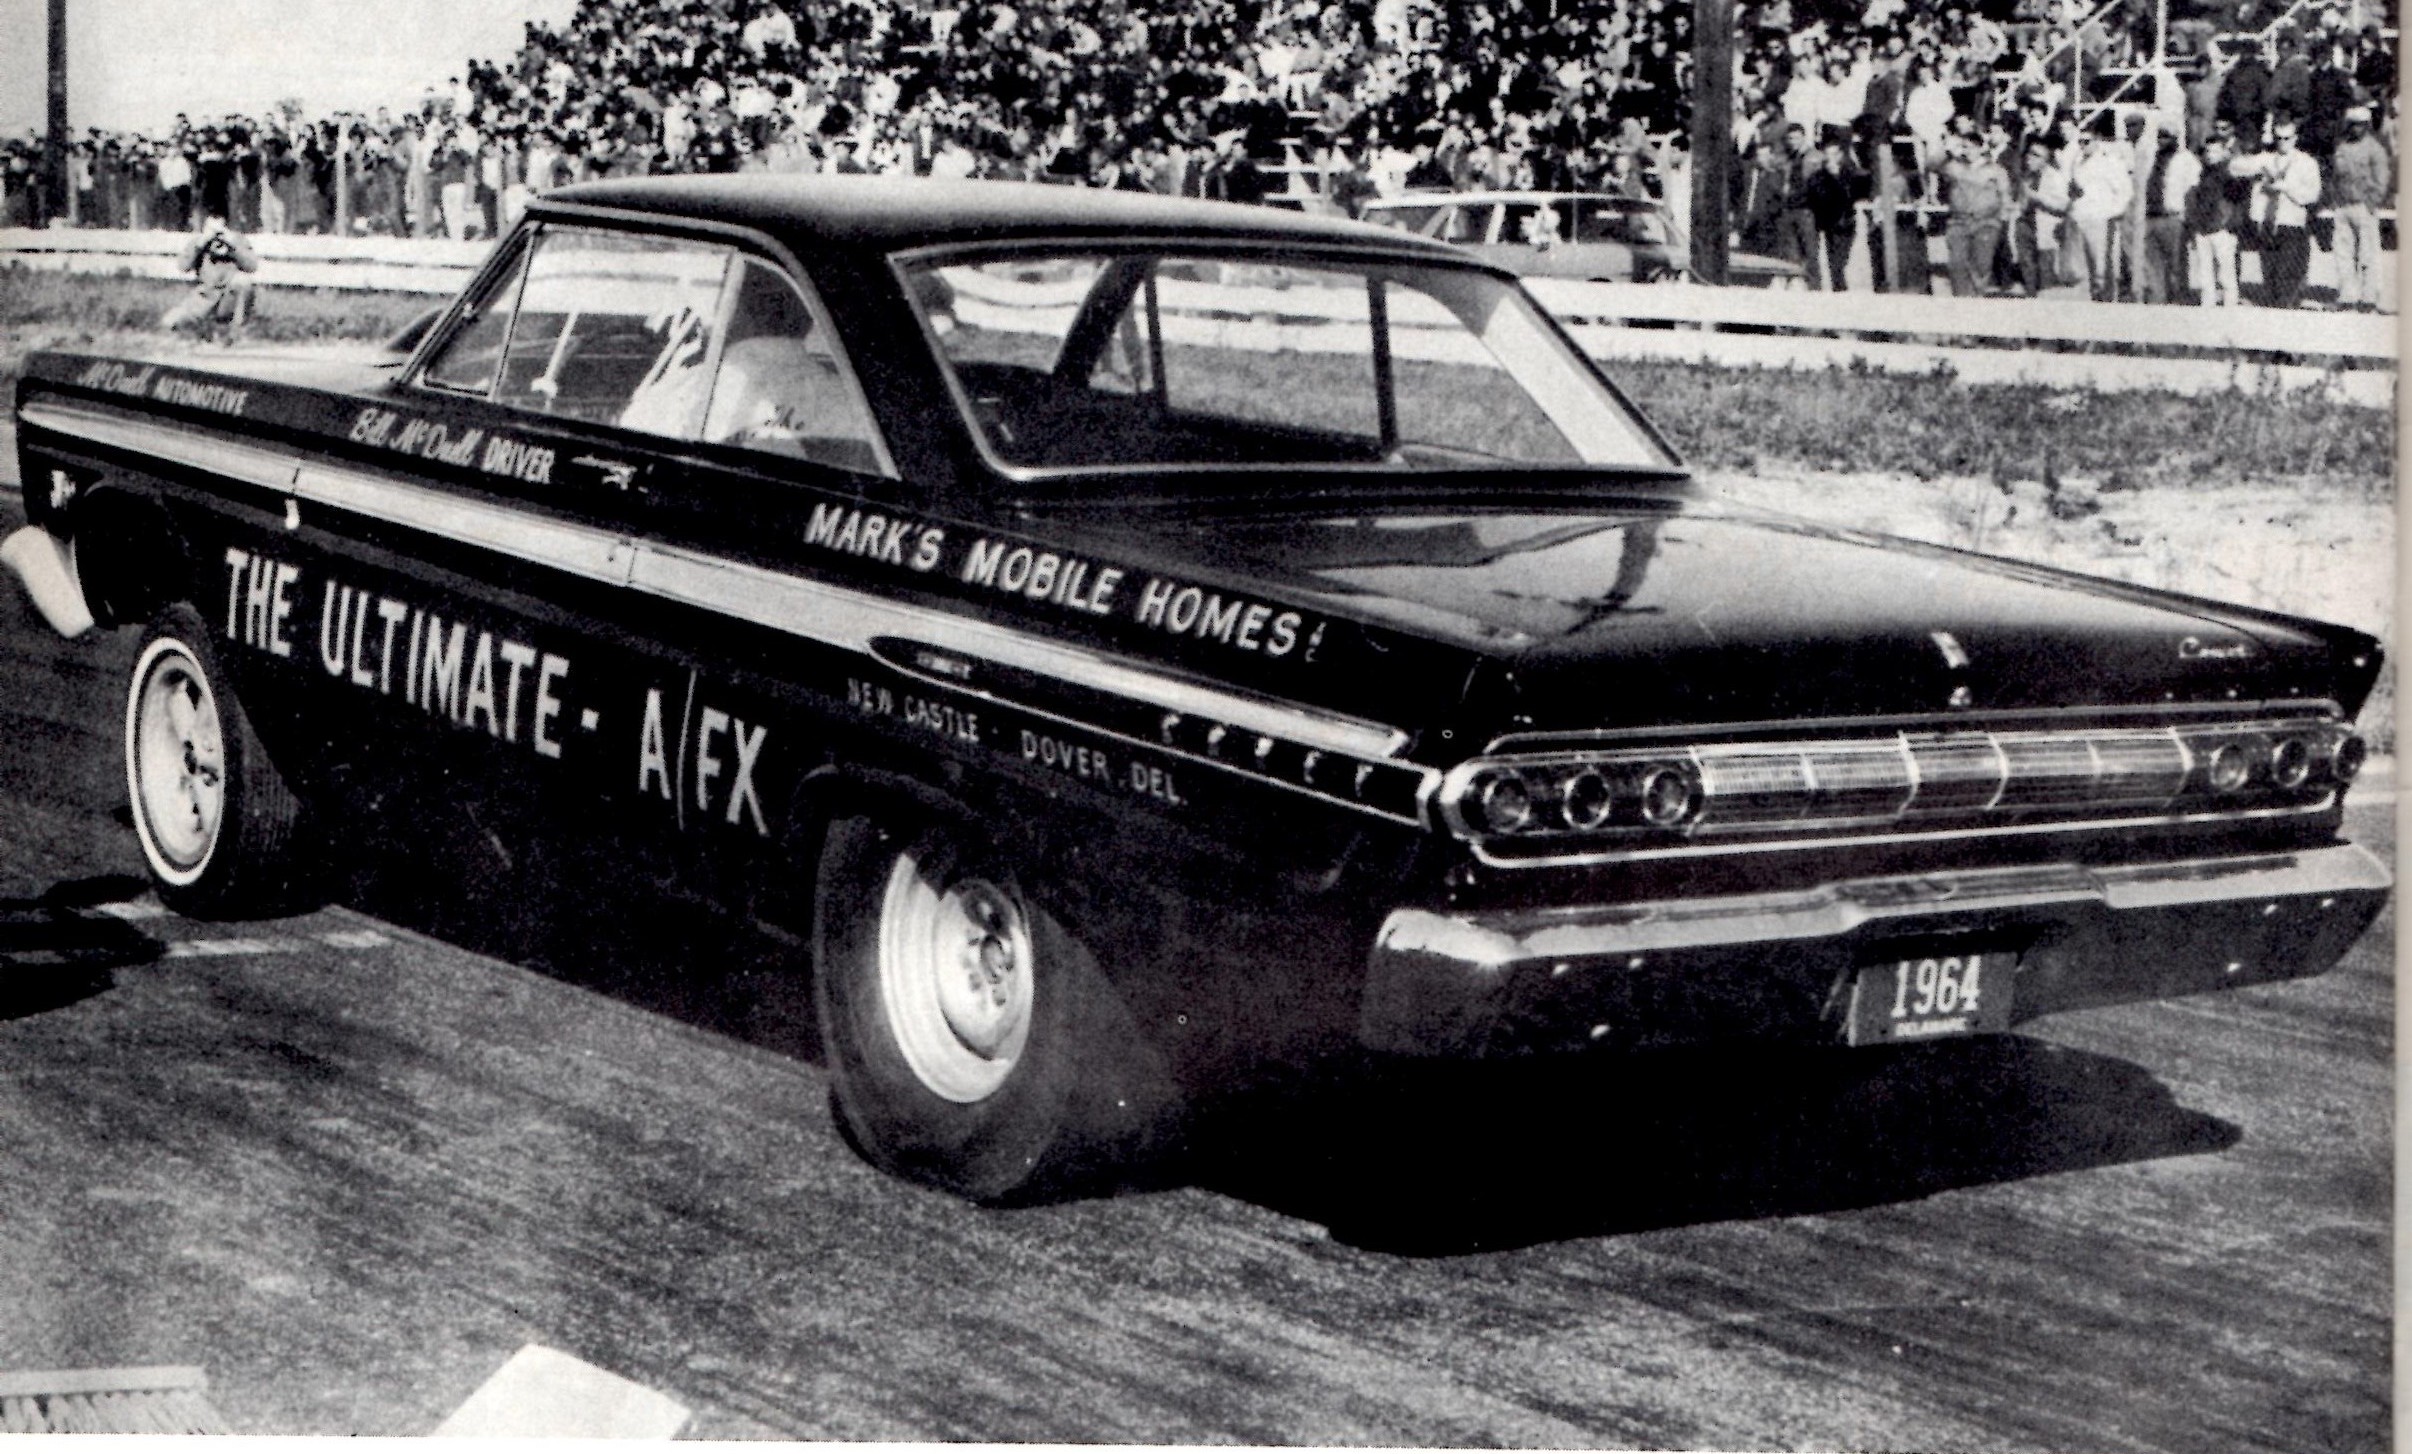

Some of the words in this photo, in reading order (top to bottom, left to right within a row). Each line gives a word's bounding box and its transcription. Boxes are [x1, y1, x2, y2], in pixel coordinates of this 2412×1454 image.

[153, 376, 248, 416] AUTOMOTIVE
[350, 407, 397, 448] Bill
[480, 436, 555, 485] DRIVER
[804, 503, 946, 572] MARK'S
[962, 540, 1124, 616] MOBILE
[1137, 577, 1302, 656] HOMES
[226, 547, 299, 657] THE
[639, 667, 769, 837] A/FX
[847, 678, 893, 716] NEW
[904, 695, 980, 742] CASTLE
[1890, 955, 1982, 1018] 1964
